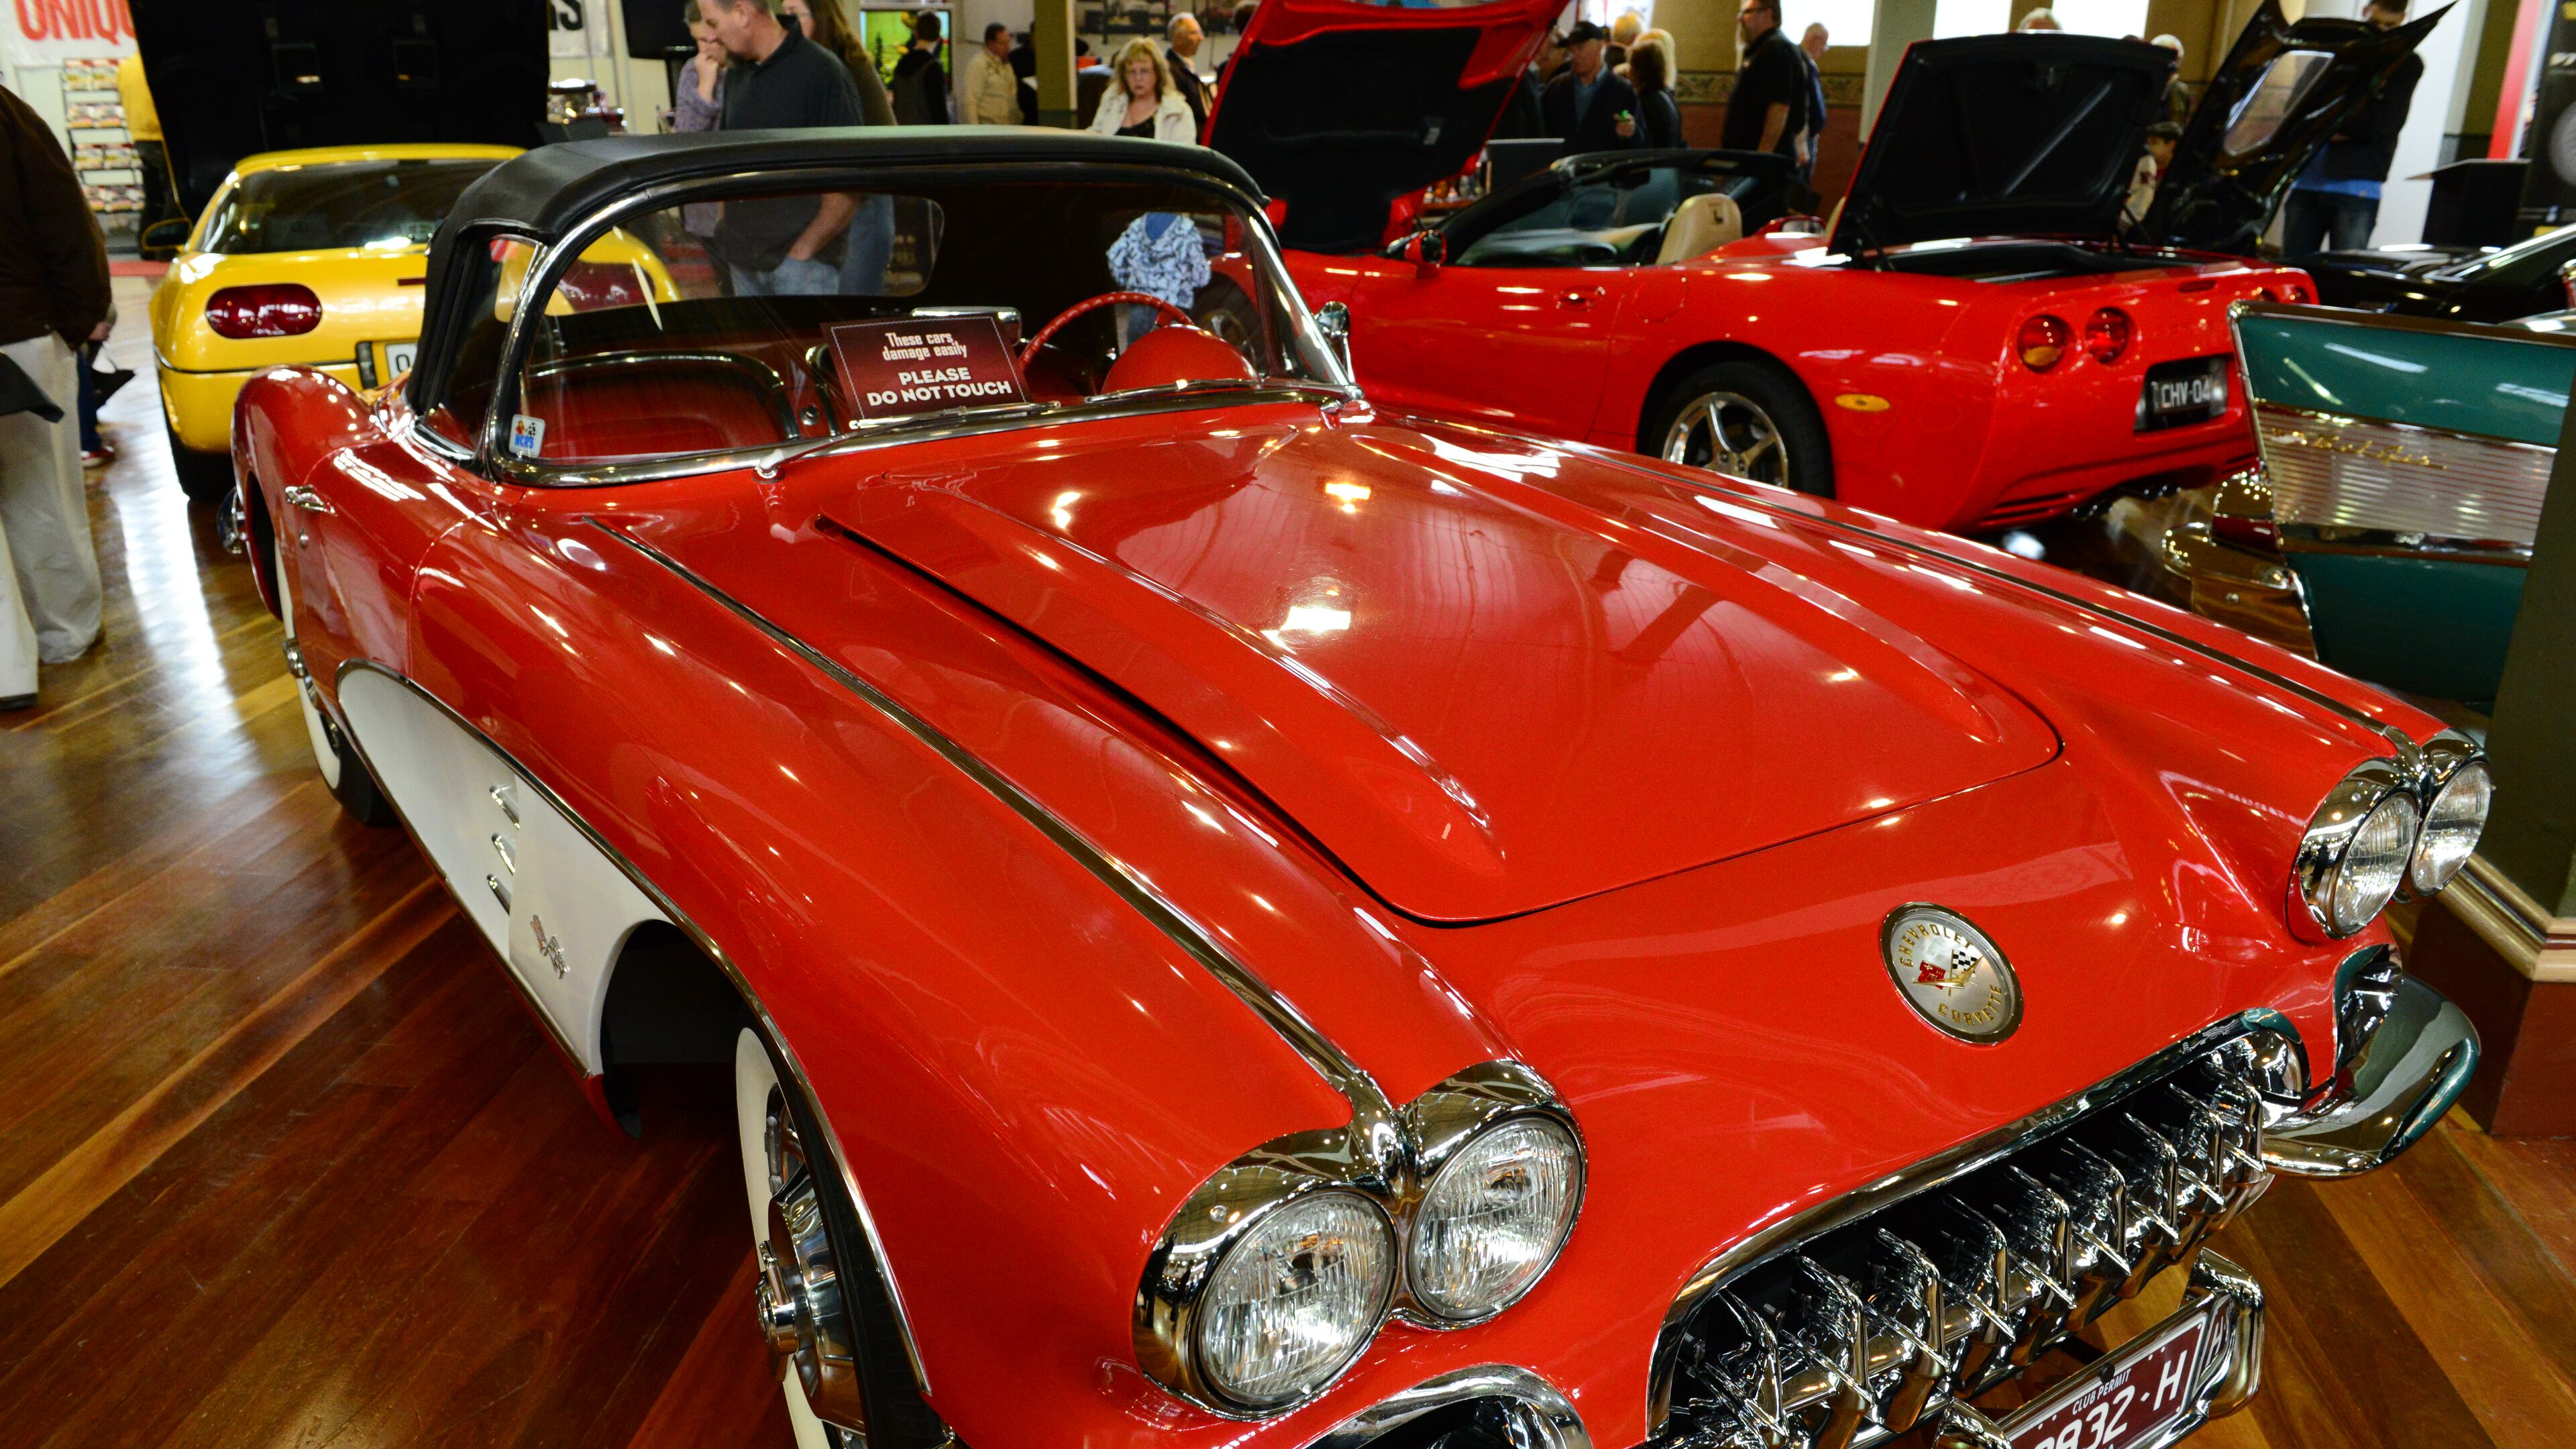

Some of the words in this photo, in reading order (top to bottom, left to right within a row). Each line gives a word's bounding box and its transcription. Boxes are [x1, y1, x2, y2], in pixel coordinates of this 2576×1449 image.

[882, 346, 930, 361] damage
[934, 341, 967, 358] easily
[885, 332, 923, 347] These
[926, 333, 953, 344] cars
[898, 367, 971, 385] PLEASE
[867, 390, 898, 406] DO
[901, 386, 941, 402] NOT
[943, 381, 1012, 398] TOUCH
[1898, 924, 1974, 967] CHEVROLET
[1938, 985, 2002, 1026] CORVETTE
[2072, 1389, 2096, 1415] CLUB
[2097, 1368, 2132, 1400] PERMIT
